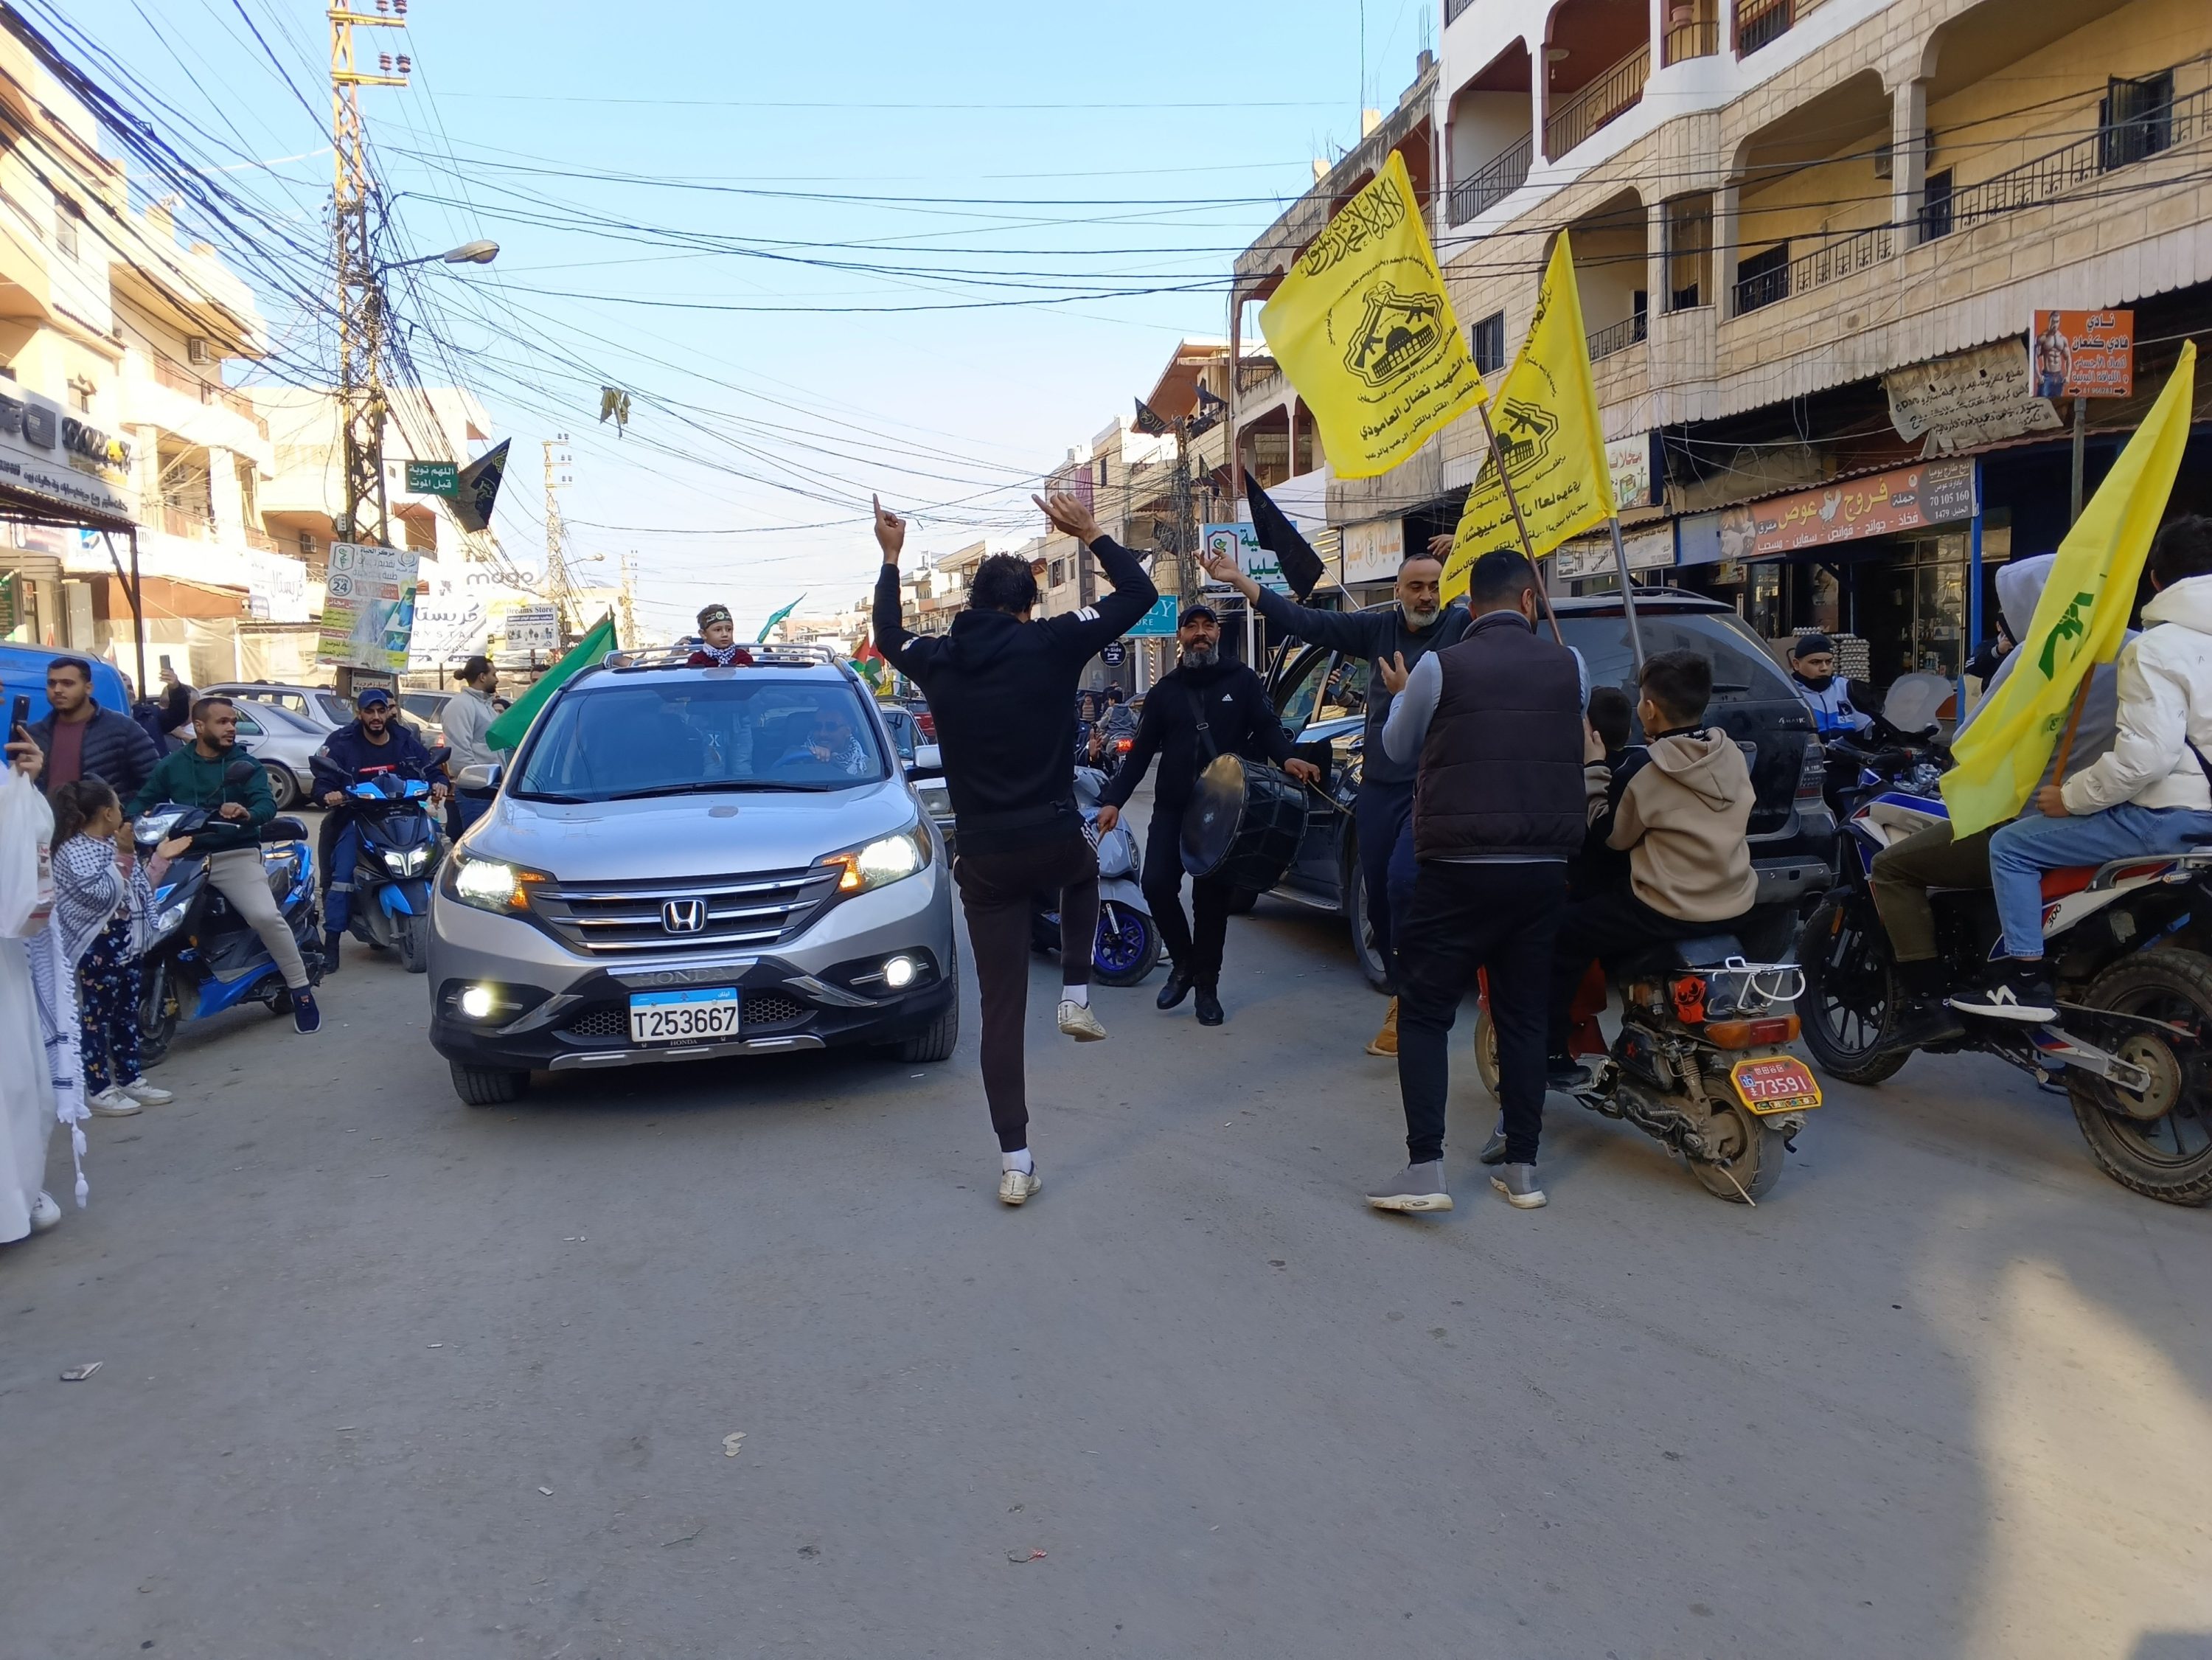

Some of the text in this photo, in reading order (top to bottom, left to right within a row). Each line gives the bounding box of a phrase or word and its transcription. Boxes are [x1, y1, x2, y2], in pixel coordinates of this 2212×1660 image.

[2087, 313, 2115, 331] نادي
[2072, 335, 2129, 353] فادي كنعان
[1433, 357, 1464, 392] الشهيد
[1403, 383, 1430, 414] نضال
[1610, 451, 1642, 468] محلات
[408, 464, 454, 477] اللهم توبة
[410, 478, 452, 490] قبل الموت
[1778, 476, 1888, 530] فروج عوض
[1892, 493, 1915, 506] جملة
[1930, 490, 1969, 507] 70 105 160
[1935, 510, 1950, 519] 1479
[1758, 521, 1777, 535] مفرق
[1758, 512, 1919, 552] فخاذ جوانح قوانص سفاين مسحب
[333, 581, 348, 592] 24
[2046, 902, 2062, 928] 300
[637, 968, 730, 986] HONDA
[633, 1006, 737, 1038] T253667
[669, 1038, 698, 1046] HONDA
[1755, 1074, 1807, 1096] 73591
